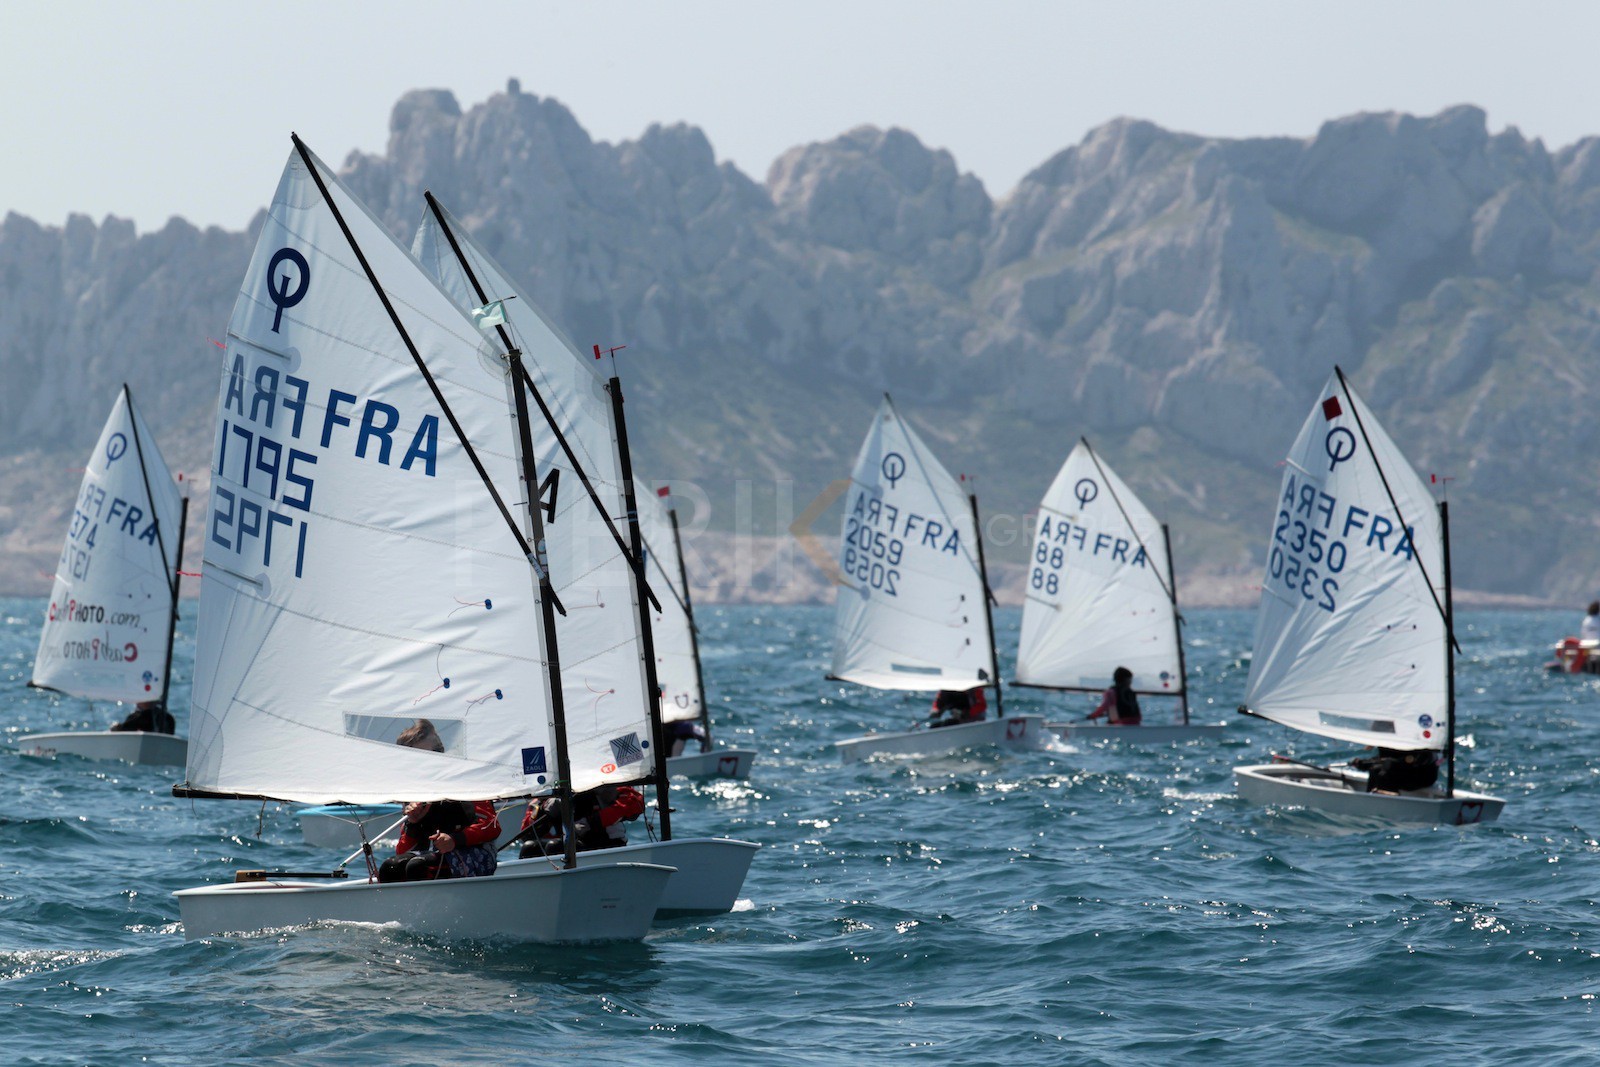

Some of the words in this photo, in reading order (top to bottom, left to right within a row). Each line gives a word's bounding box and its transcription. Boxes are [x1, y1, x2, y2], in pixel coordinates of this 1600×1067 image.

[320, 388, 439, 477] FRA
[218, 419, 318, 512] 1795
[105, 497, 159, 546] FRA
[845, 517, 904, 567] 2059
[904, 513, 960, 556] FRA
[1275, 510, 1347, 573] 2350
[1342, 505, 1415, 561] FRA
[1036, 541, 1064, 569] 88
[1093, 533, 1150, 569] FRA
